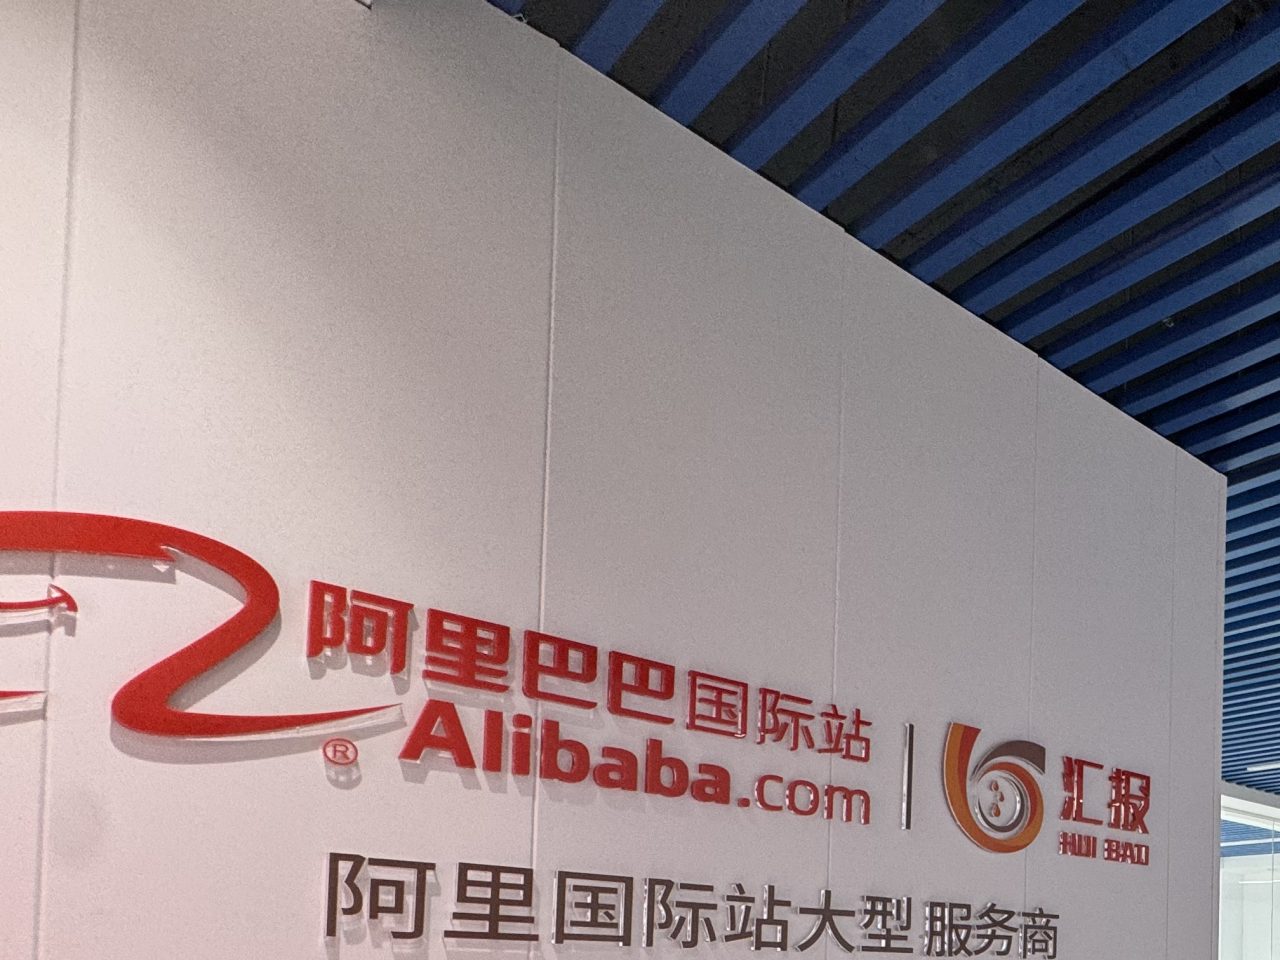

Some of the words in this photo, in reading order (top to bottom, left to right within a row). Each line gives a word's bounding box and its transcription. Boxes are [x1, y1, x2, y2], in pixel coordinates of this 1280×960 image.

[306, 579, 872, 763] 阿里巴巴国际站
[399, 699, 871, 825] Alibaba.com
[1059, 755, 1151, 835] 汇报
[326, 852, 1060, 960] 阿里国际站大型服务商
